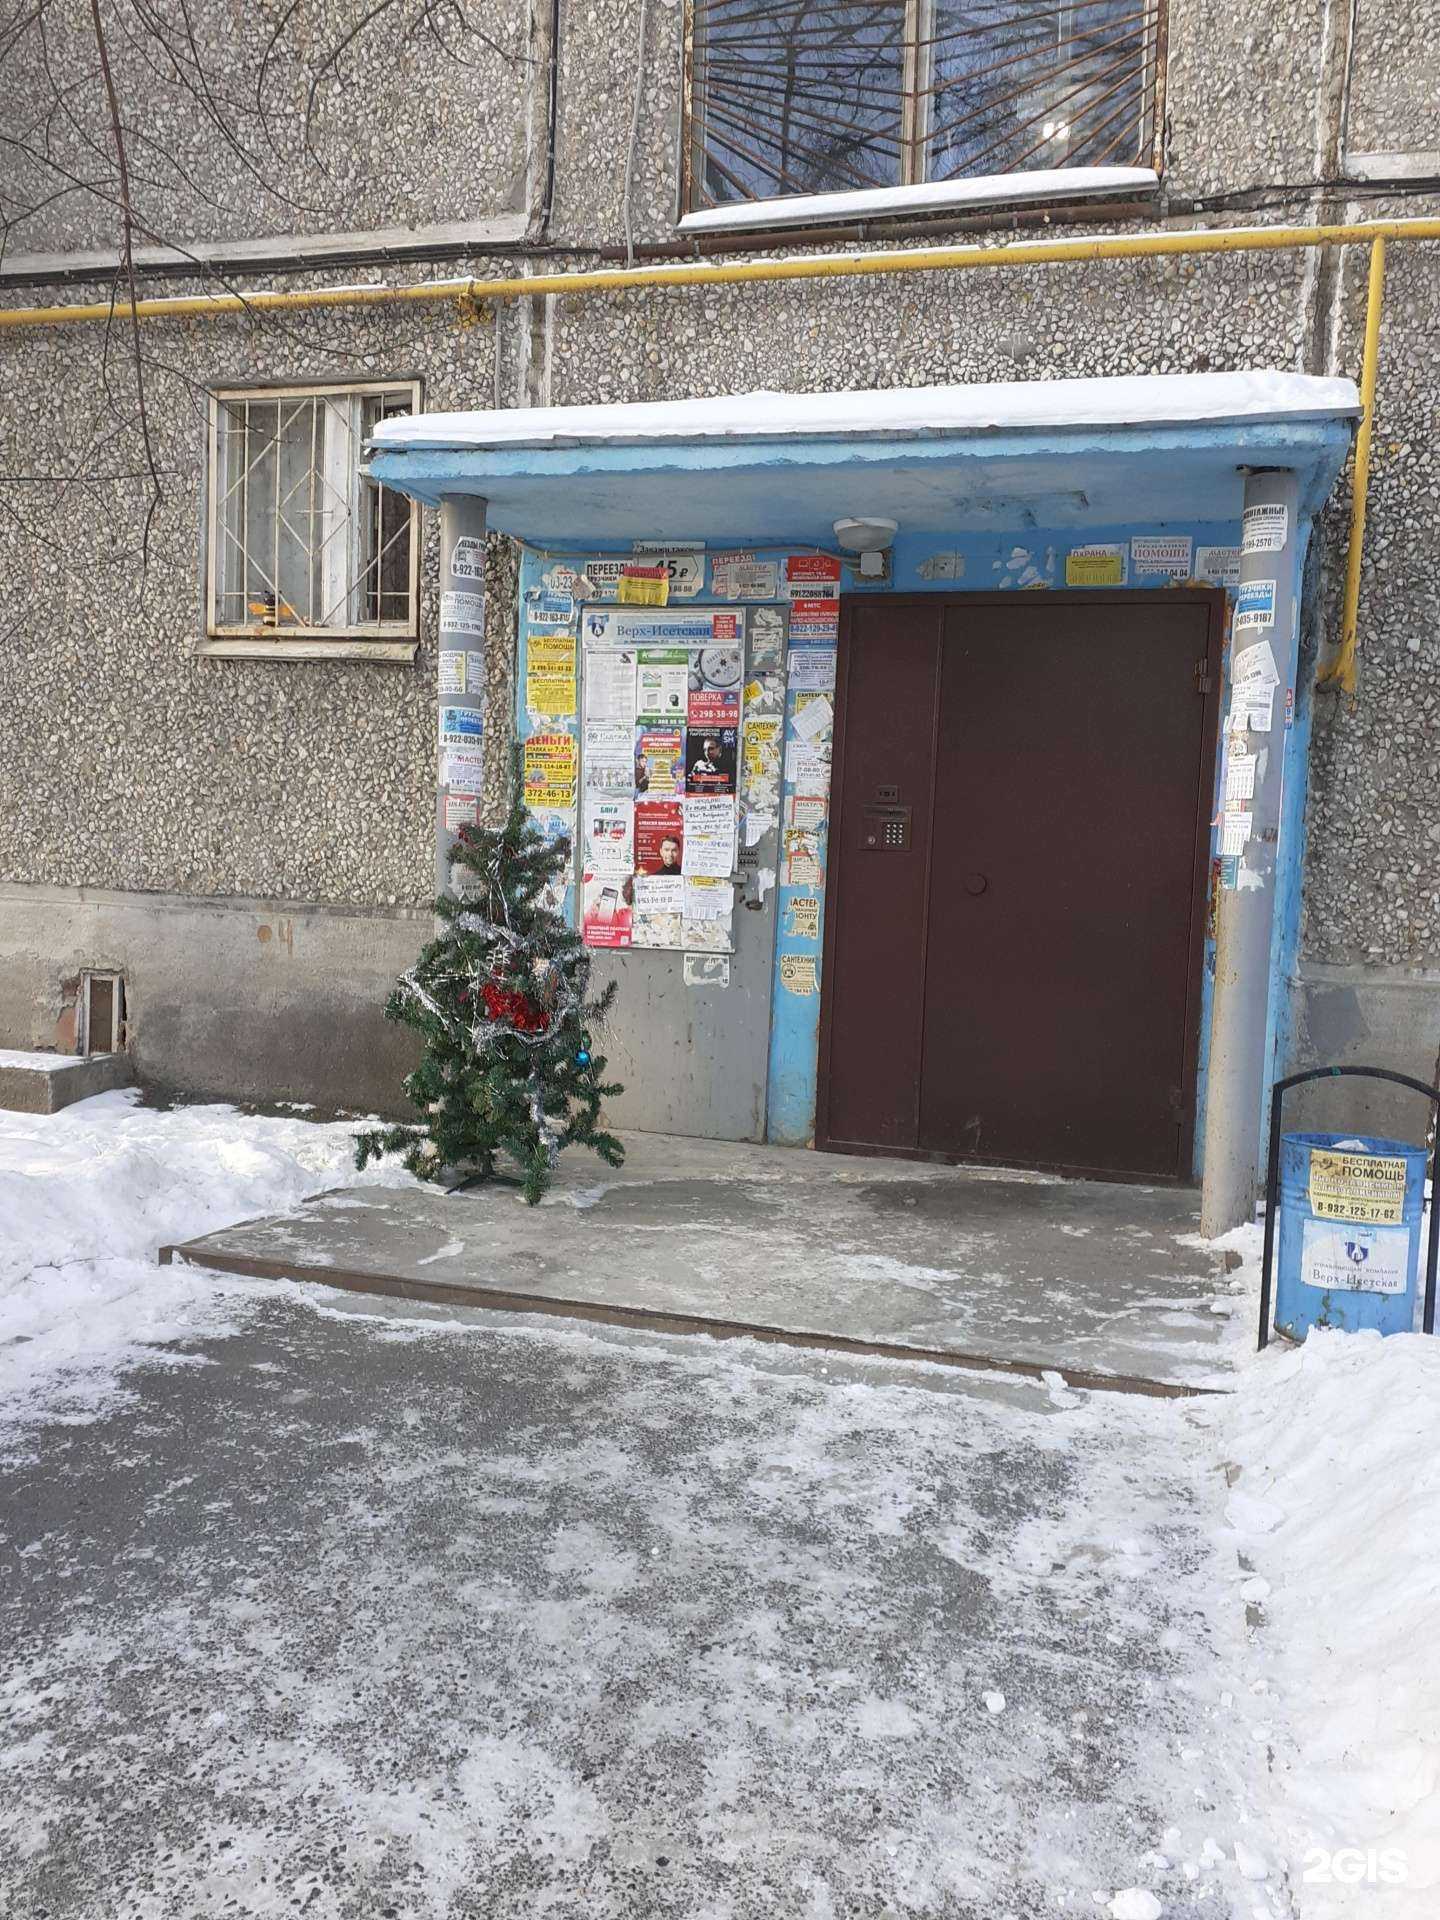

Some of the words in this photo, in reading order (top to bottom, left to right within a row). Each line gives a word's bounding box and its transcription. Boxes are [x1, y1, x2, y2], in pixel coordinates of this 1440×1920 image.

[690, 692, 722, 701] ПОВЕРКА
[699, 710, 738, 718] 298-38-98
[526, 735, 571, 746] ДЕНЬГИ
[527, 789, 571, 798] 372-46-13
[1342, 1156, 1406, 1169] БЕСПЛАТНАЯ
[1341, 1166, 1405, 1182] ПОМОЩЬ
[1317, 1201, 1395, 1220] 8-932-125-17-62
[1312, 1268, 1399, 1288] Верх-Исетская
